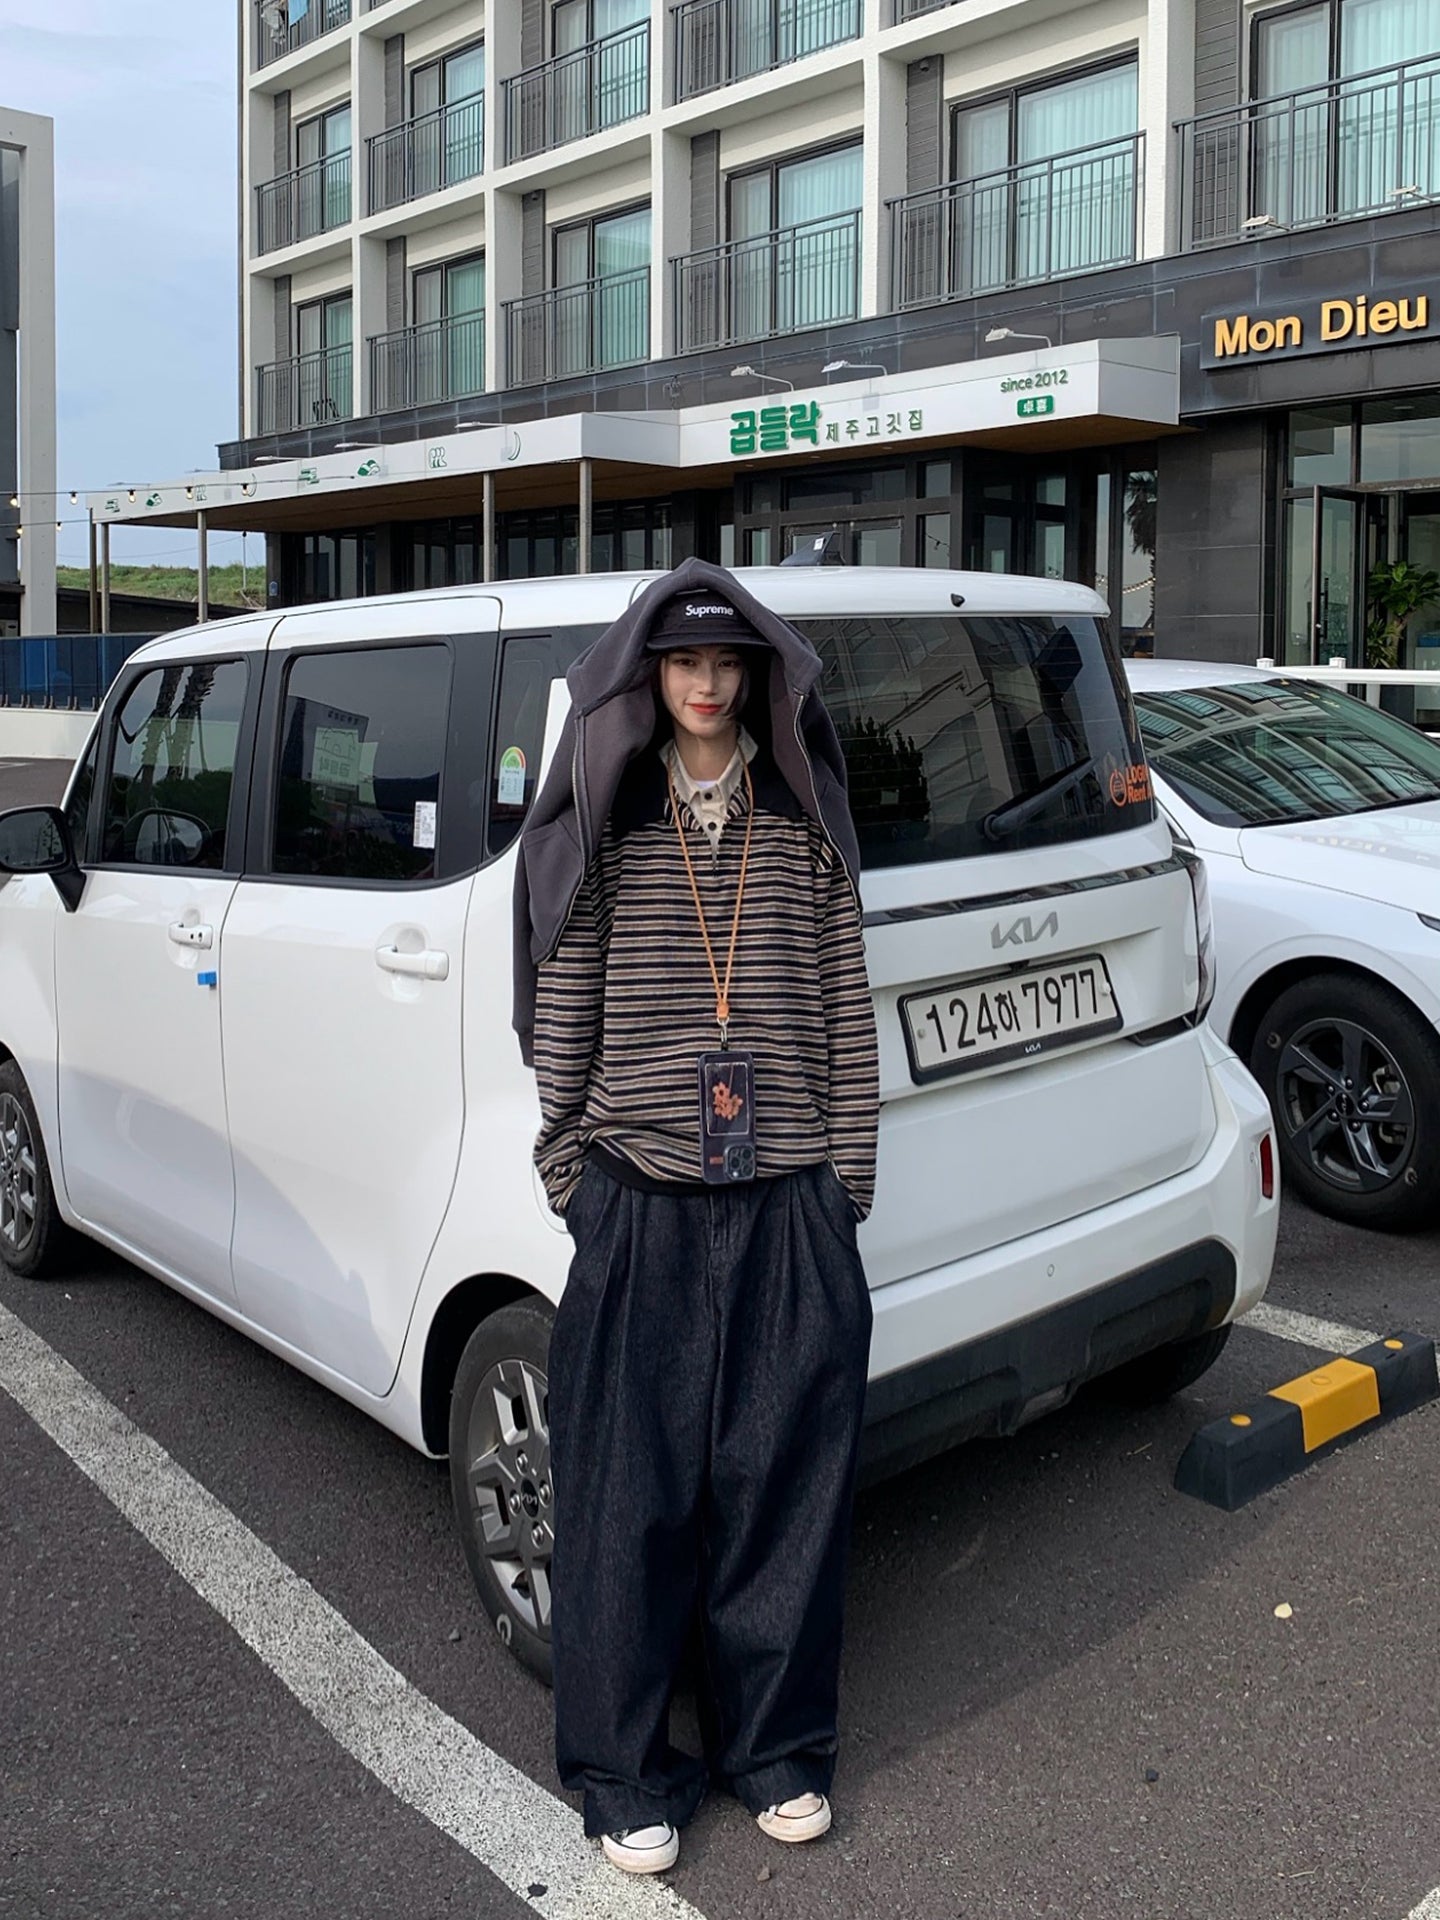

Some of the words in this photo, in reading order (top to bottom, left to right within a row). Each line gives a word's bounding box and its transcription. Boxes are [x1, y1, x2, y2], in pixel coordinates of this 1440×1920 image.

[1214, 315, 1301, 357] Mon
[1321, 295, 1427, 341] Dieu
[1000, 376, 1032, 393] since
[1035, 369, 1068, 388] 2012
[729, 400, 821, 455] 곱들락
[685, 604, 734, 618] Supreme
[990, 911, 1059, 949] KIA
[1025, 1042, 1042, 1054] KIA
